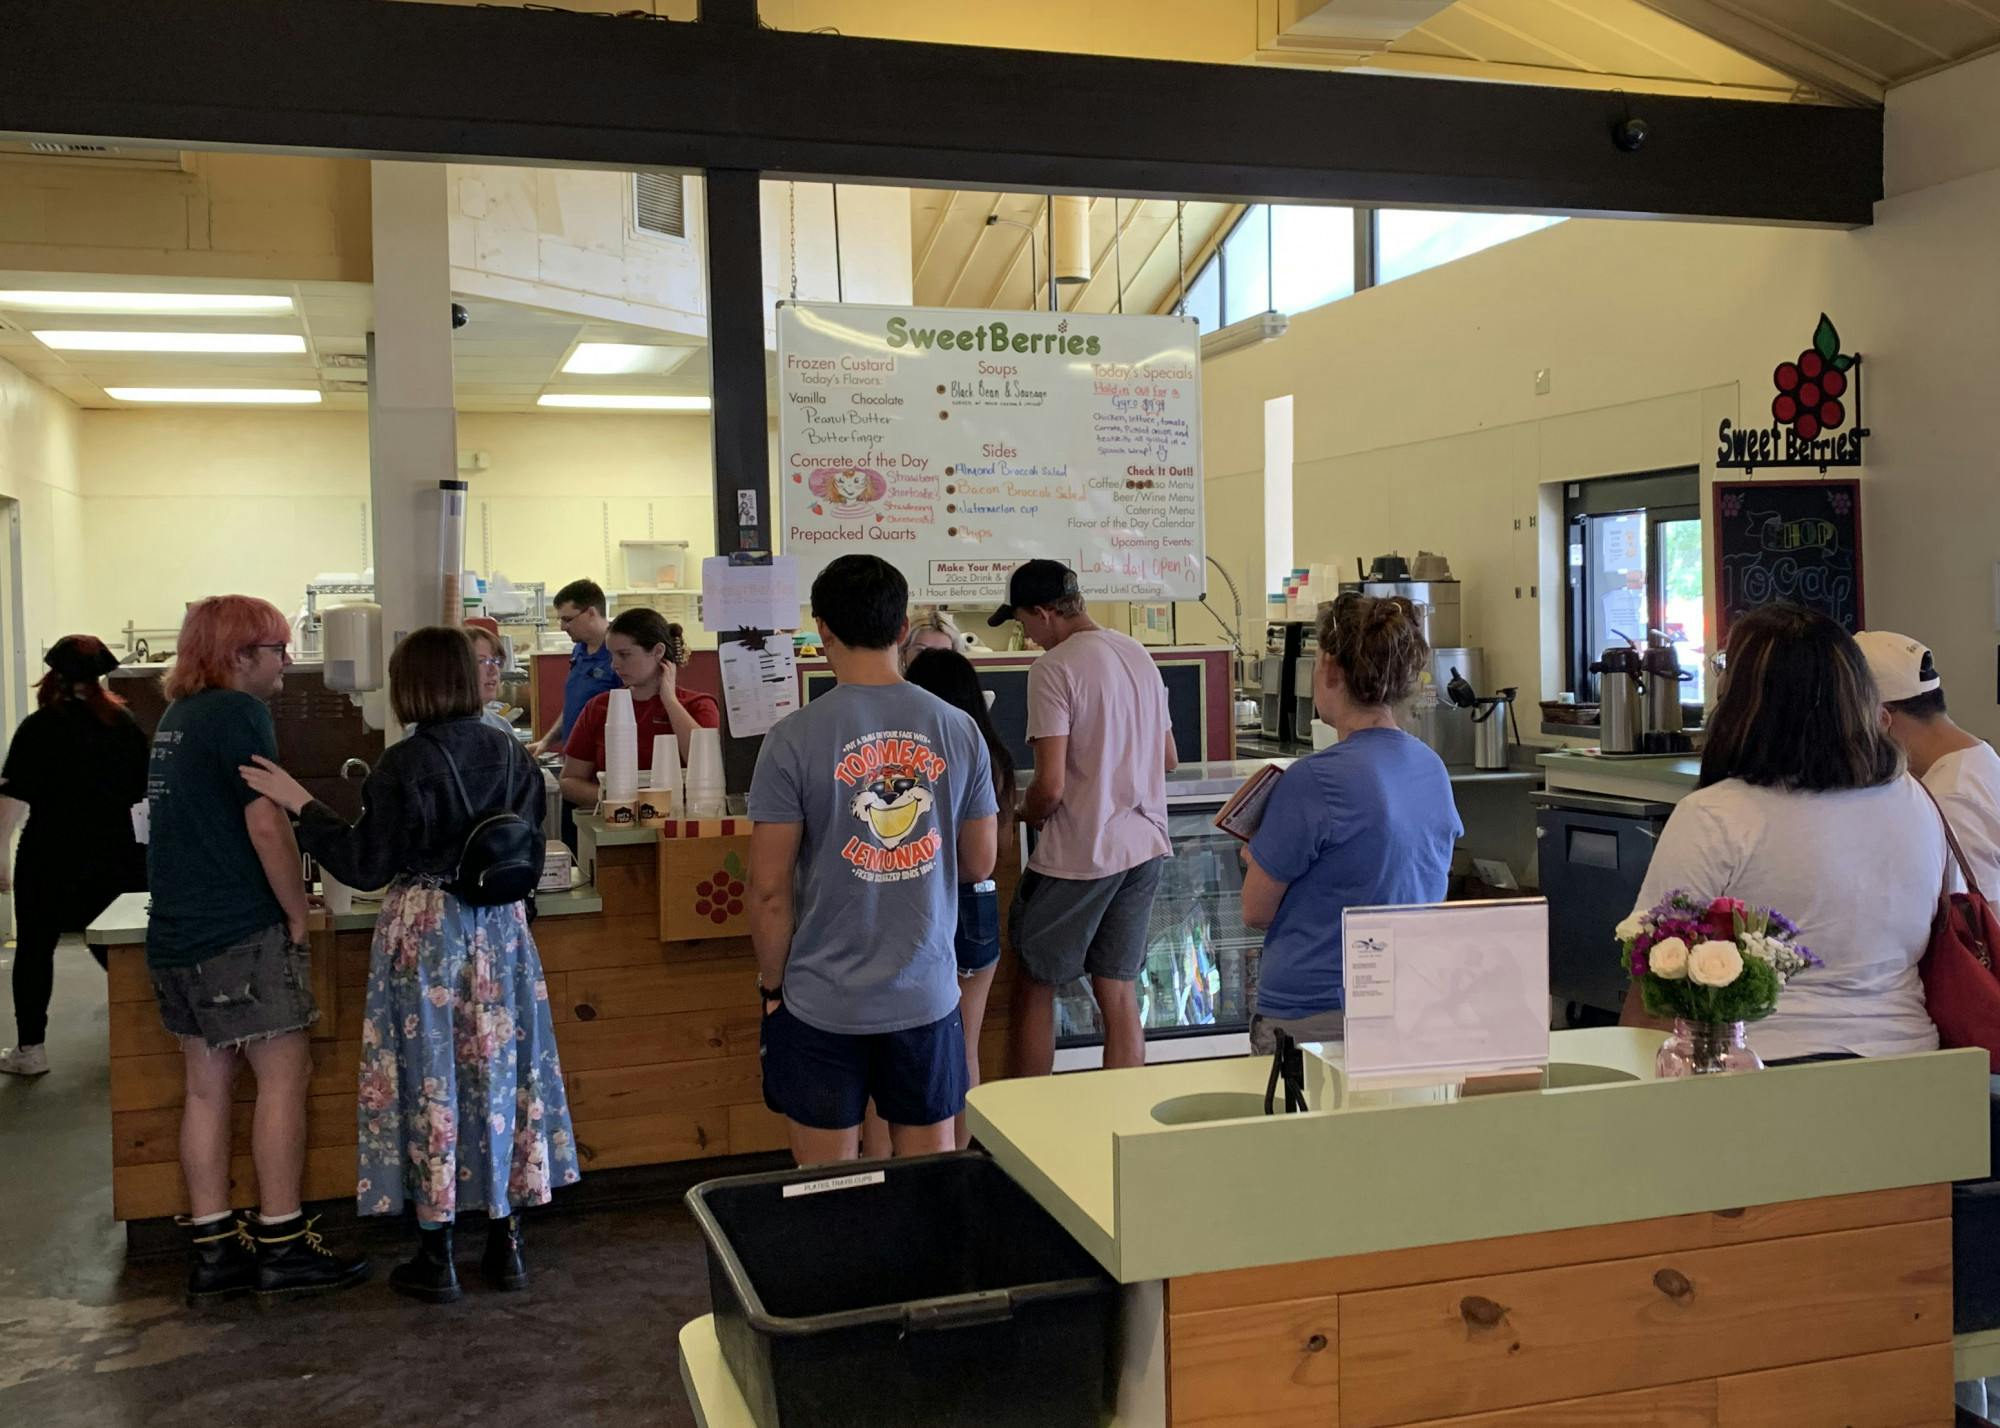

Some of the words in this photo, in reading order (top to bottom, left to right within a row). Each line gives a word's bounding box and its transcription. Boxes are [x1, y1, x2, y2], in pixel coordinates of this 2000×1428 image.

[886, 317, 1100, 356] SweetBerries
[788, 355, 836, 370] Frozen
[841, 357, 895, 372] Custard
[978, 361, 1018, 378] Soups
[1092, 363, 1139, 380] Today's
[1143, 363, 1193, 381] Specials
[801, 373, 840, 387] Today's
[951, 380, 973, 398] Black
[978, 380, 1000, 398] Bean
[789, 392, 827, 404] Vanilla
[851, 393, 905, 405] Chocolate
[800, 407, 846, 425] Peanut
[849, 409, 893, 425] Butter
[982, 443, 1017, 458] Sides
[790, 453, 853, 468] Concrete
[858, 453, 874, 468] of
[876, 453, 897, 468] the
[901, 454, 929, 471] Day
[955, 463, 996, 477] Almond
[1127, 466, 1154, 476] Check
[1158, 467, 1166, 476] It
[1169, 466, 1194, 477] Out!!
[957, 480, 1000, 496] Bacon
[1168, 480, 1194, 489] Menu
[1112, 492, 1167, 502] Beer/Wine
[1169, 492, 1195, 502] Menu
[1125, 504, 1167, 518] Catering
[1169, 505, 1195, 516] Menu
[1067, 517, 1097, 528] Flavor
[1100, 516, 1111, 528] of
[1113, 516, 1127, 528] the
[1130, 518, 1150, 530] Day
[1152, 518, 1195, 528] Calendar
[791, 525, 864, 544] Prepacked
[868, 525, 916, 541] Quarts
[957, 524, 993, 544] Chips
[1111, 537, 1160, 549] Upcoming
[1162, 536, 1192, 547] Events
[937, 562, 964, 573] Make
[968, 562, 990, 573] Your
[1122, 552, 1145, 580] day
[945, 573, 967, 583] 20oz
[970, 573, 993, 582] Drink
[926, 588, 948, 598] Hour
[950, 586, 978, 597] Before
[979, 585, 1006, 597] Closin
[1080, 585, 1109, 595] Served
[1110, 584, 1130, 595] Until
[1131, 585, 1162, 597] Closing
[835, 739, 947, 787] TOOMER'S
